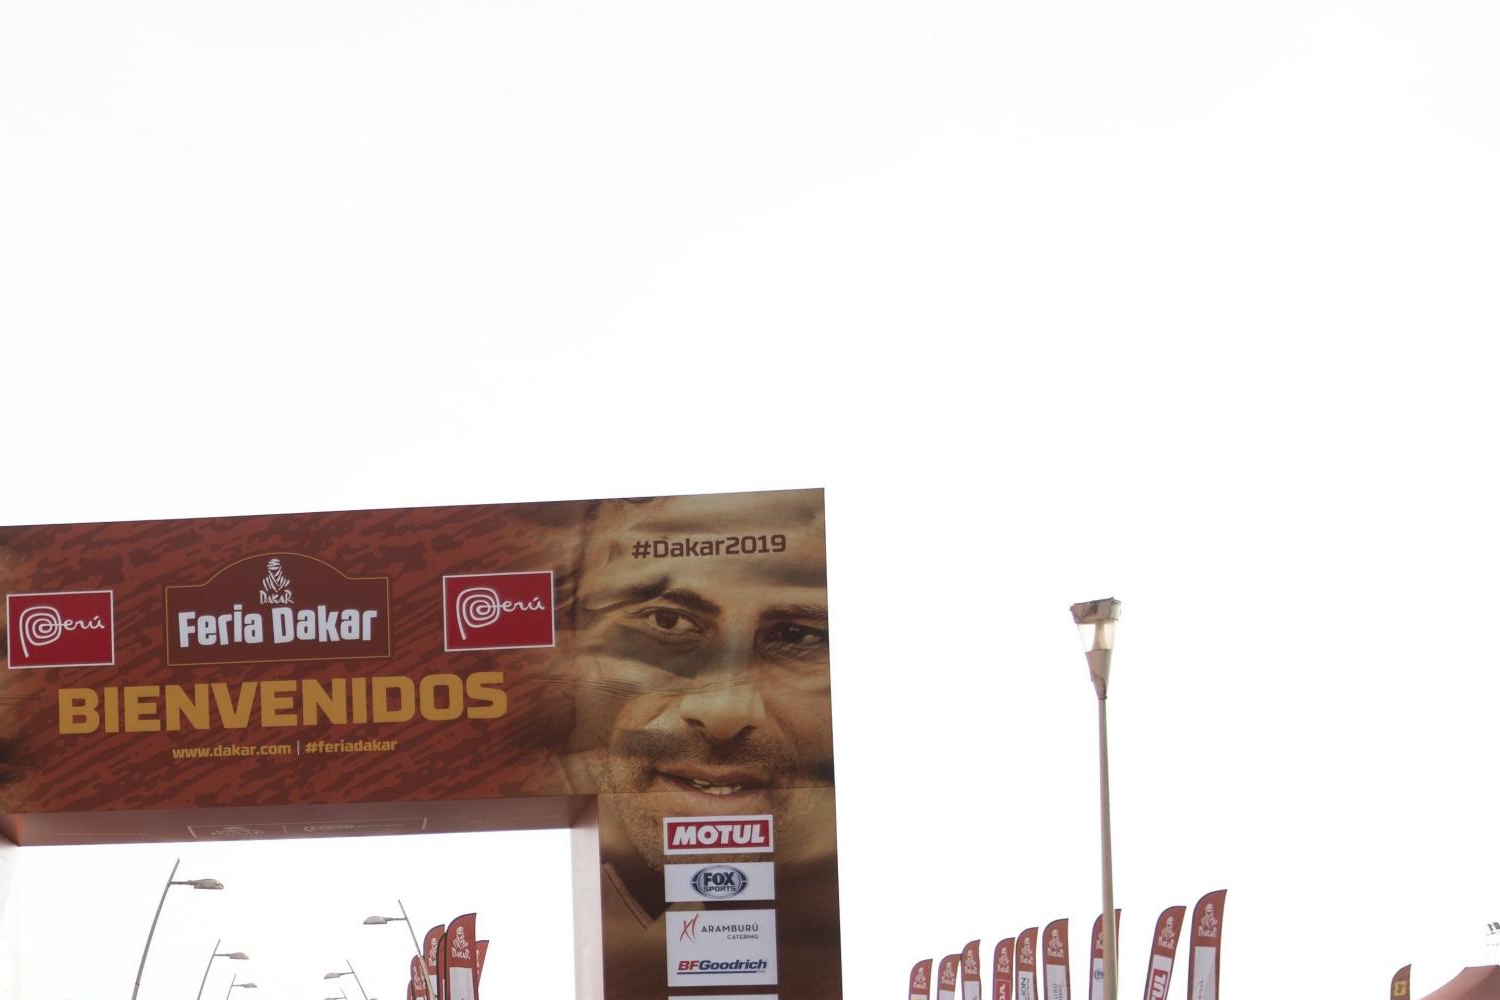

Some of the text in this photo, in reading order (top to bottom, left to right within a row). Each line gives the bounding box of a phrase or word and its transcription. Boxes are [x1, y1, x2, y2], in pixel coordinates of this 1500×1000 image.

[631, 534, 786, 559] #Dakar2019
[455, 587, 546, 641] Perú
[19, 605, 105, 658] Perú
[177, 604, 378, 648] Feria Dakar
[58, 671, 508, 735] BIENVENIDOS
[172, 738, 398, 759] www.dakar.com #feriadakar
[672, 824, 765, 846] MOTUL
[703, 871, 735, 886] FOX
[701, 922, 759, 933] ARAMBURÚ
[678, 959, 768, 971] BFGoodrich
